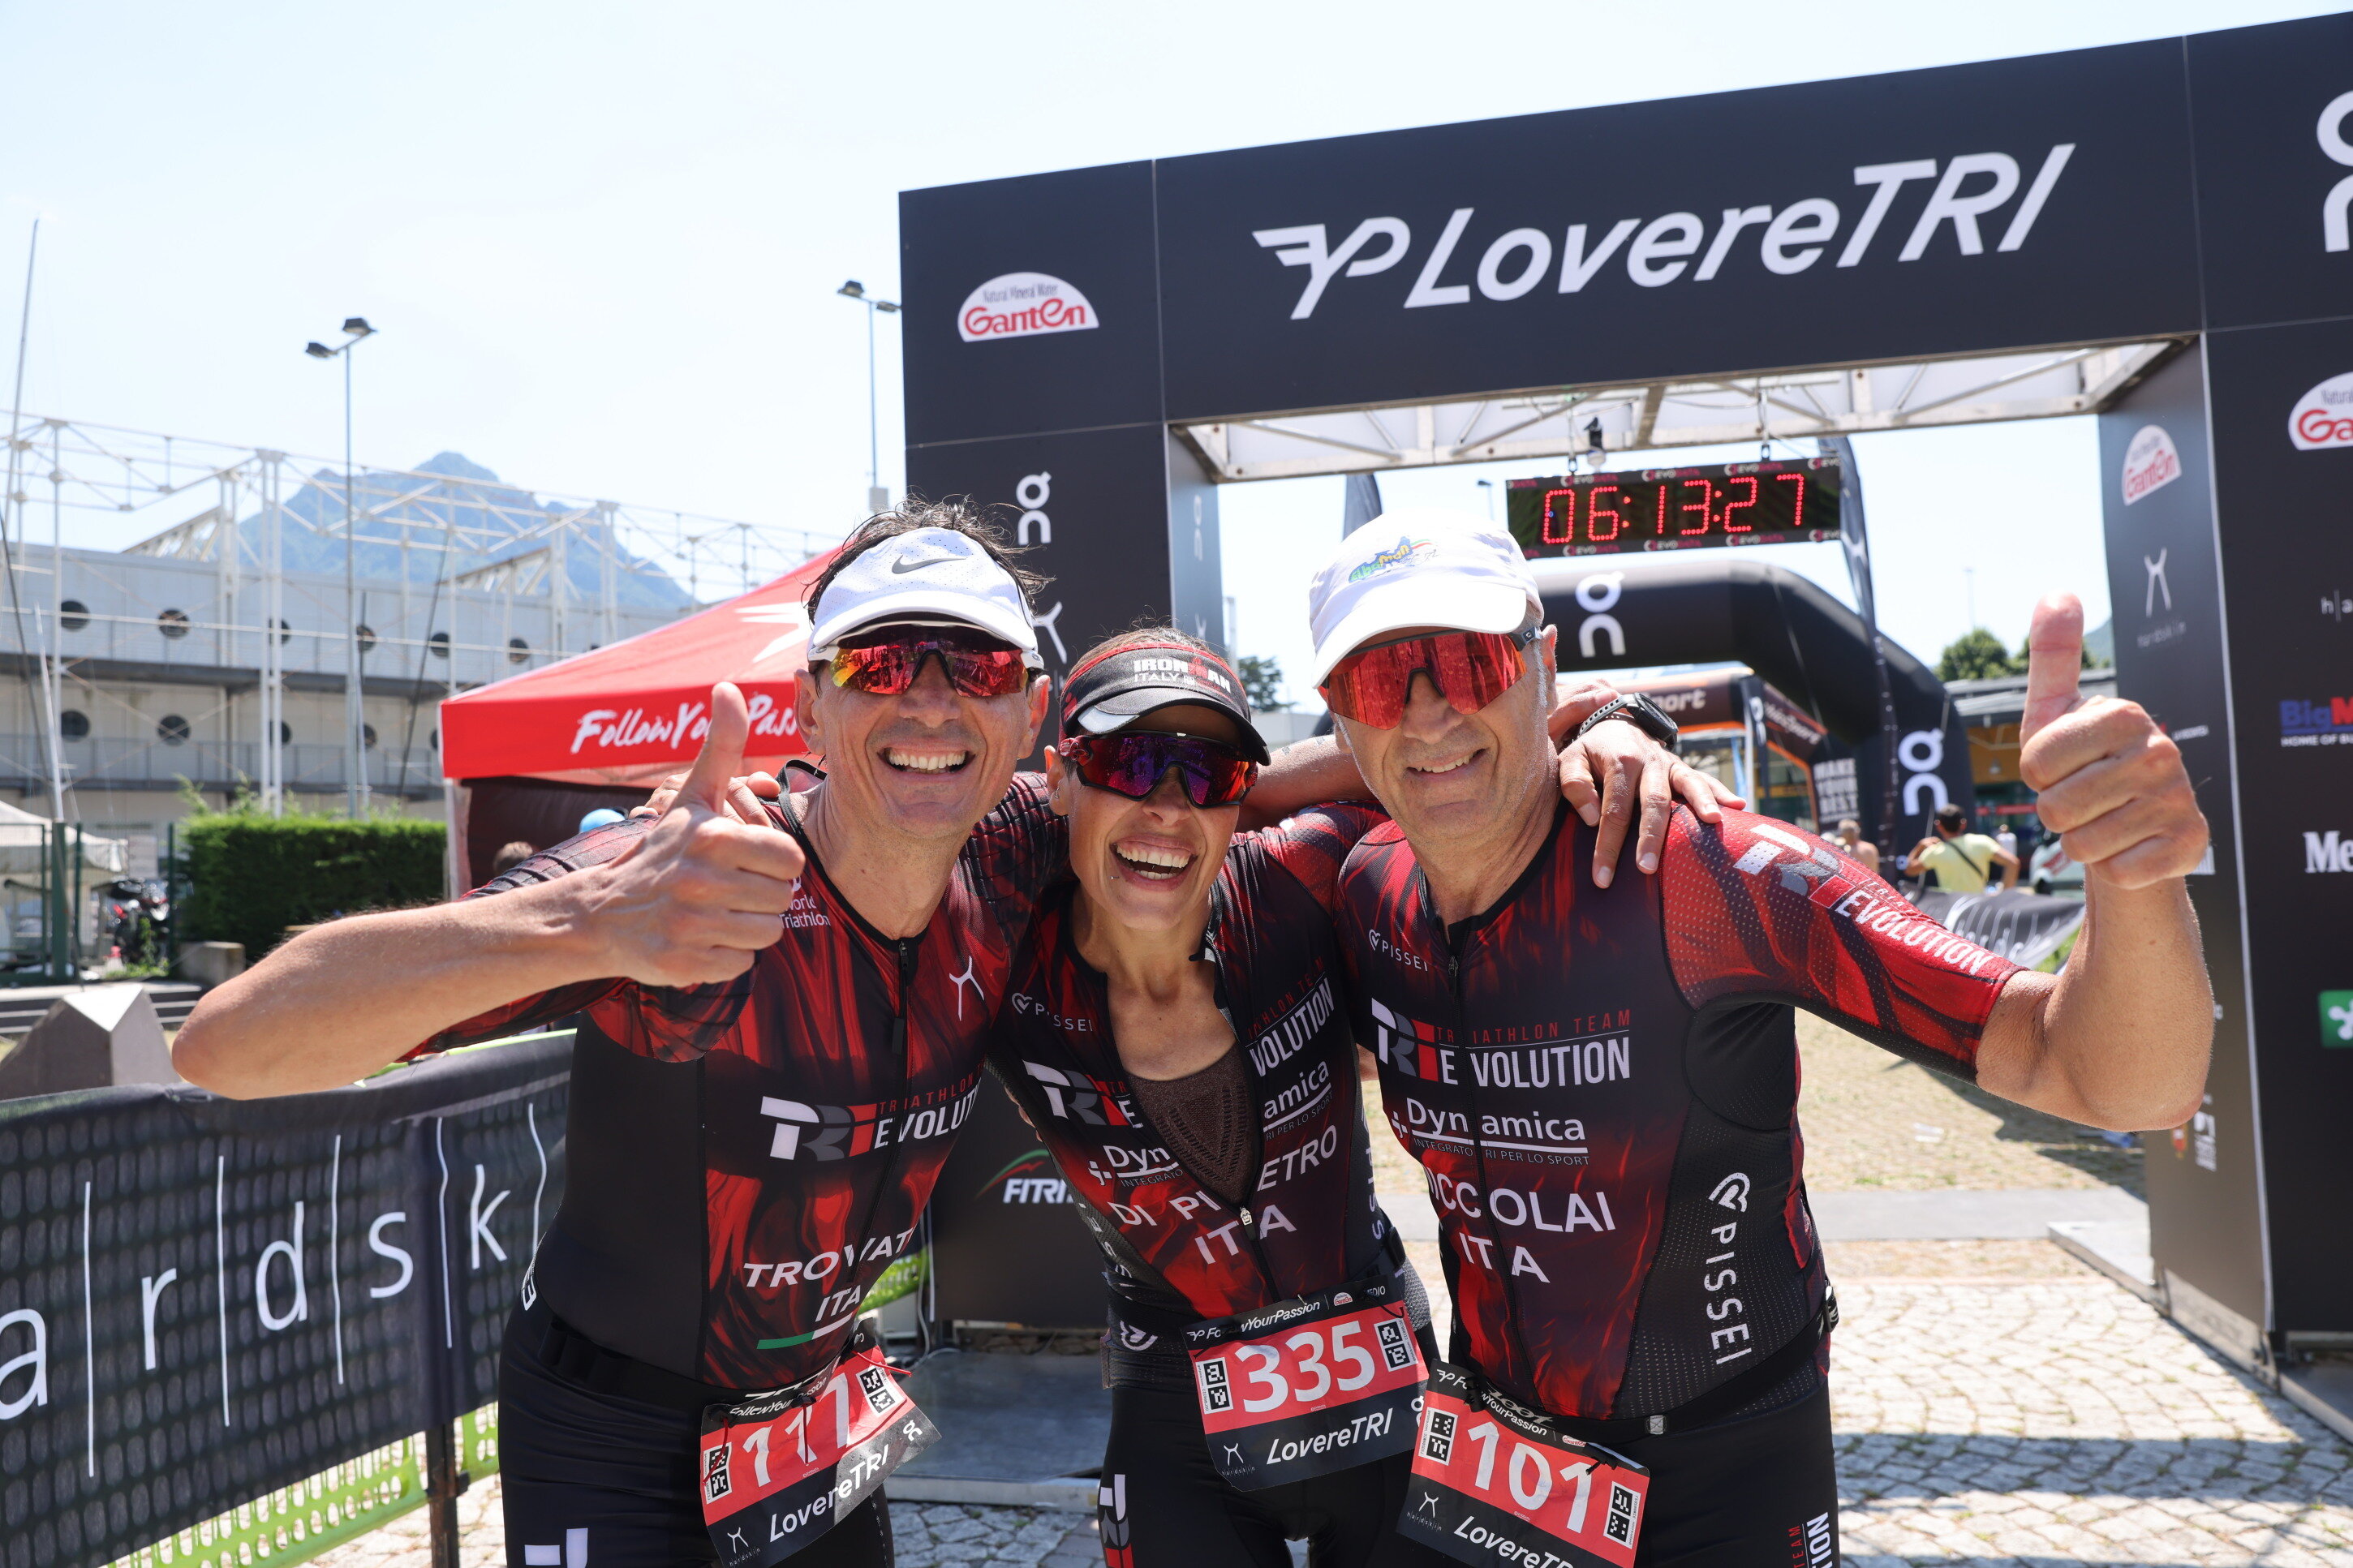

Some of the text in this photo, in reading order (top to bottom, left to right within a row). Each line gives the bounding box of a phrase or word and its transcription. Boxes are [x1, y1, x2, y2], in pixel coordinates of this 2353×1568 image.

[1404, 142, 2076, 309] LovereTRI
[1133, 672, 1179, 682] ITALY
[779, 911, 831, 929] Triathlon
[1835, 889, 1994, 975] EVOLUTION
[1382, 943, 1429, 972] PISSEI
[1035, 1003, 1093, 1032] PSSEI
[1573, 1009, 1631, 1034] TEAM
[875, 1077, 982, 1149] EVOLUT
[1501, 1150, 1524, 1162] PER
[1528, 1153, 1543, 1164] LO
[1547, 1155, 1589, 1166] SPORT
[1107, 1201, 1158, 1226] DI
[743, 1226, 918, 1288] TROVAT
[815, 1284, 861, 1323] ITA
[1704, 1222, 1753, 1365] PISSEI
[1234, 1320, 1376, 1413] 335
[742, 1370, 852, 1488] 111
[1266, 1407, 1393, 1465] LovereTRI
[770, 1444, 889, 1543] LovereTRI
[1467, 1420, 1593, 1534] 101
[1453, 1515, 1575, 1568] LovereT
